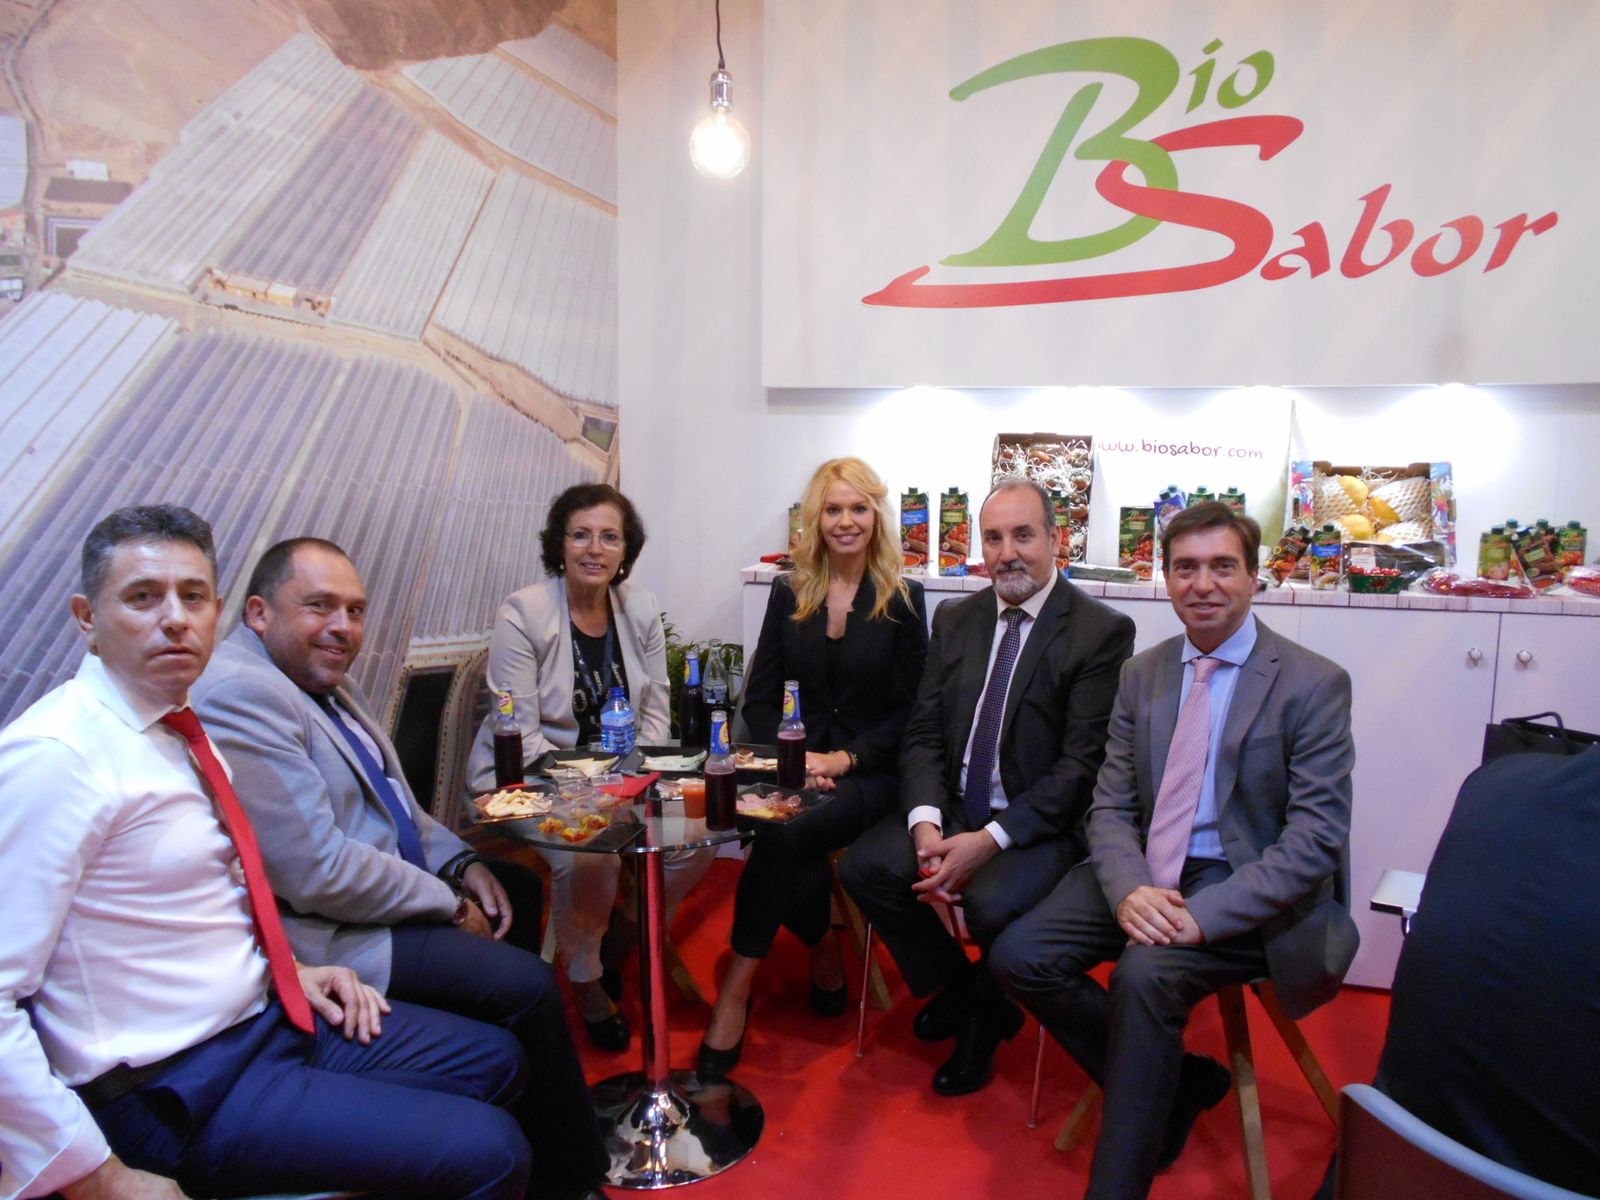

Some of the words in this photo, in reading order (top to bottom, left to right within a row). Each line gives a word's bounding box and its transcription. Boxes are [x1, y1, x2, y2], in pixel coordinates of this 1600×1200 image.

[862, 115, 1558, 308] Sabor
[939, 37, 1275, 267] Bio
[1098, 439, 1263, 460] ww.biosabor.com
